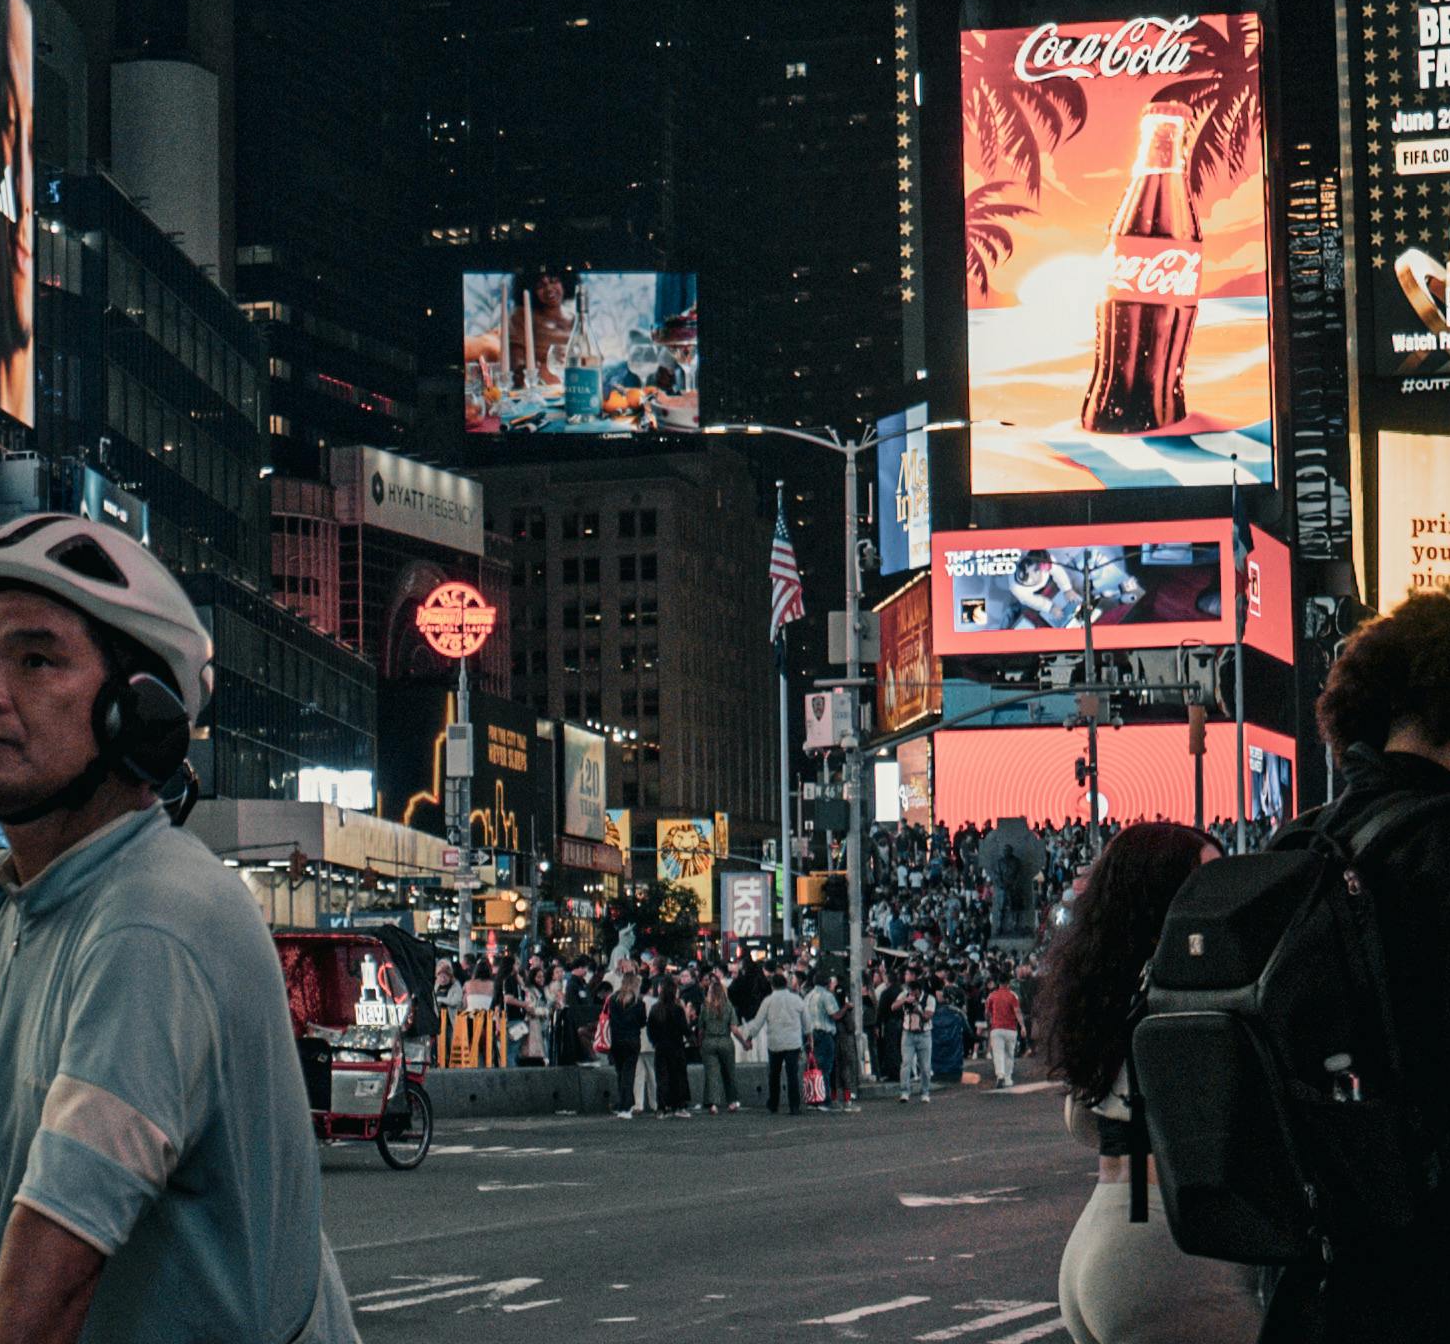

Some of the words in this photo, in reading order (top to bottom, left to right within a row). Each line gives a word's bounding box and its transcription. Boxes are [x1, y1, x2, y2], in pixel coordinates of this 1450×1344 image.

[1392, 109, 1435, 135] June
[1392, 330, 1437, 354] Watch
[388, 483, 424, 512] HYATT
[427, 492, 474, 526] REGENCY
[945, 564, 975, 577] YOU
[977, 562, 1017, 576] NEED
[733, 877, 761, 938] tkts
